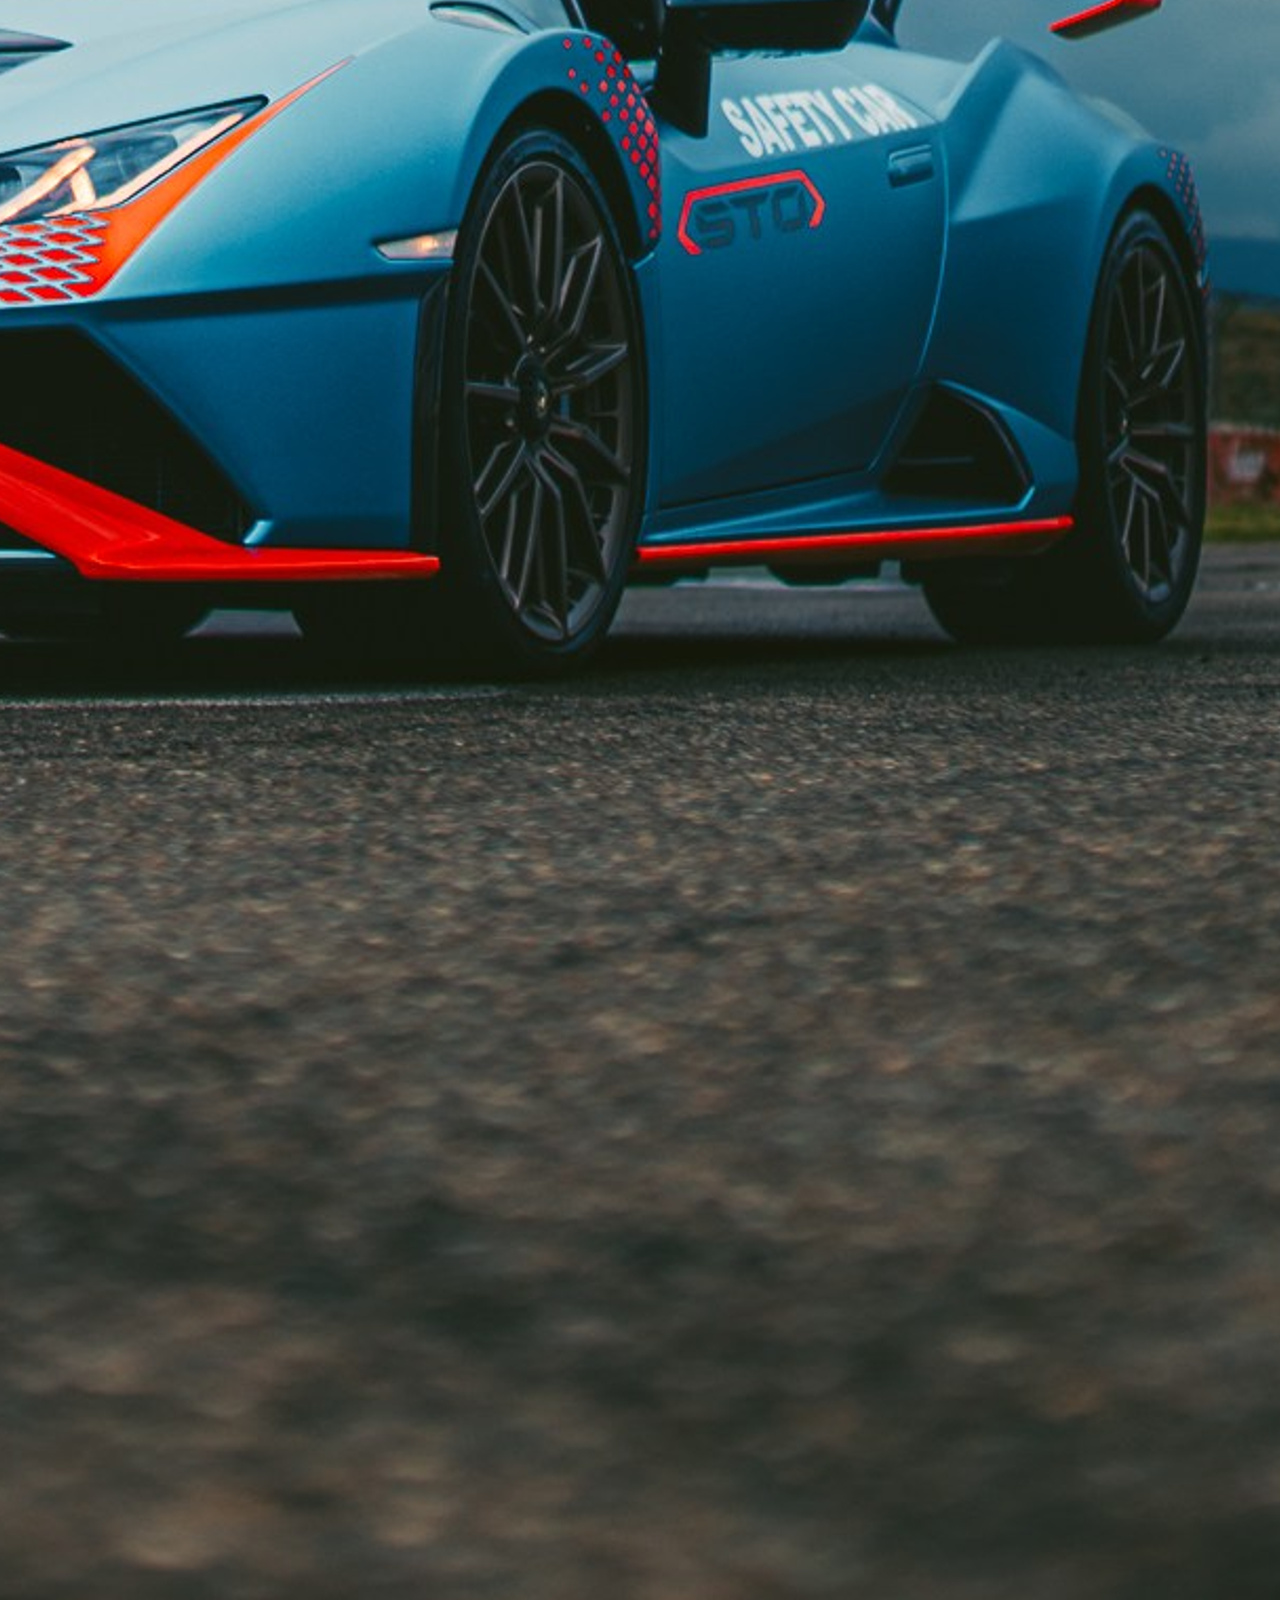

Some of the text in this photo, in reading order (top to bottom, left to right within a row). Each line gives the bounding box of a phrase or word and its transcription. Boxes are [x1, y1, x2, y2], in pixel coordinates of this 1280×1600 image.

[722, 84, 919, 157] SAFETY CAR
[696, 186, 806, 247] STO
